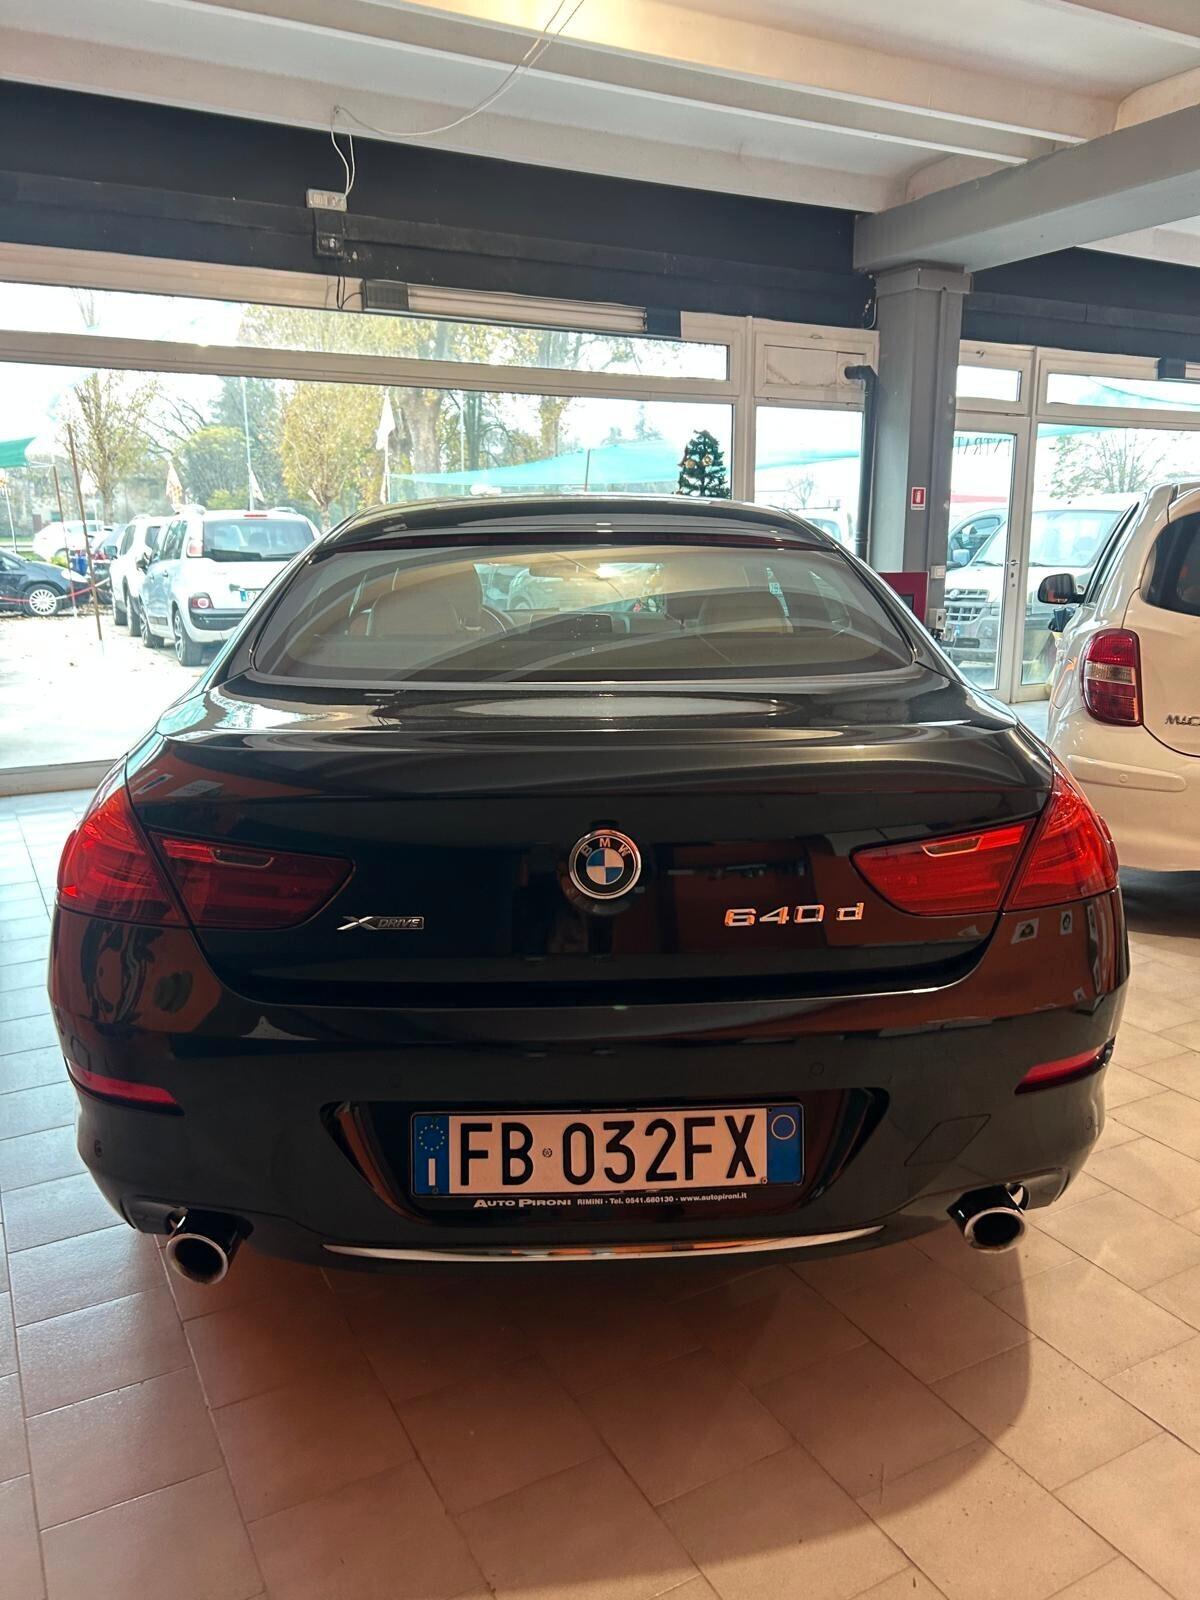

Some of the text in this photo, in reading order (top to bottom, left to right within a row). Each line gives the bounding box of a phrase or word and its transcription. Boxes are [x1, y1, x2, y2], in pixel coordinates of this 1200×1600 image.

[580, 837, 631, 858] BMW
[724, 902, 865, 927] 640 d
[460, 1115, 756, 1186] FB 032FX
[577, 1198, 603, 1206] RIMINI
[609, 1197, 624, 1205] Tel.
